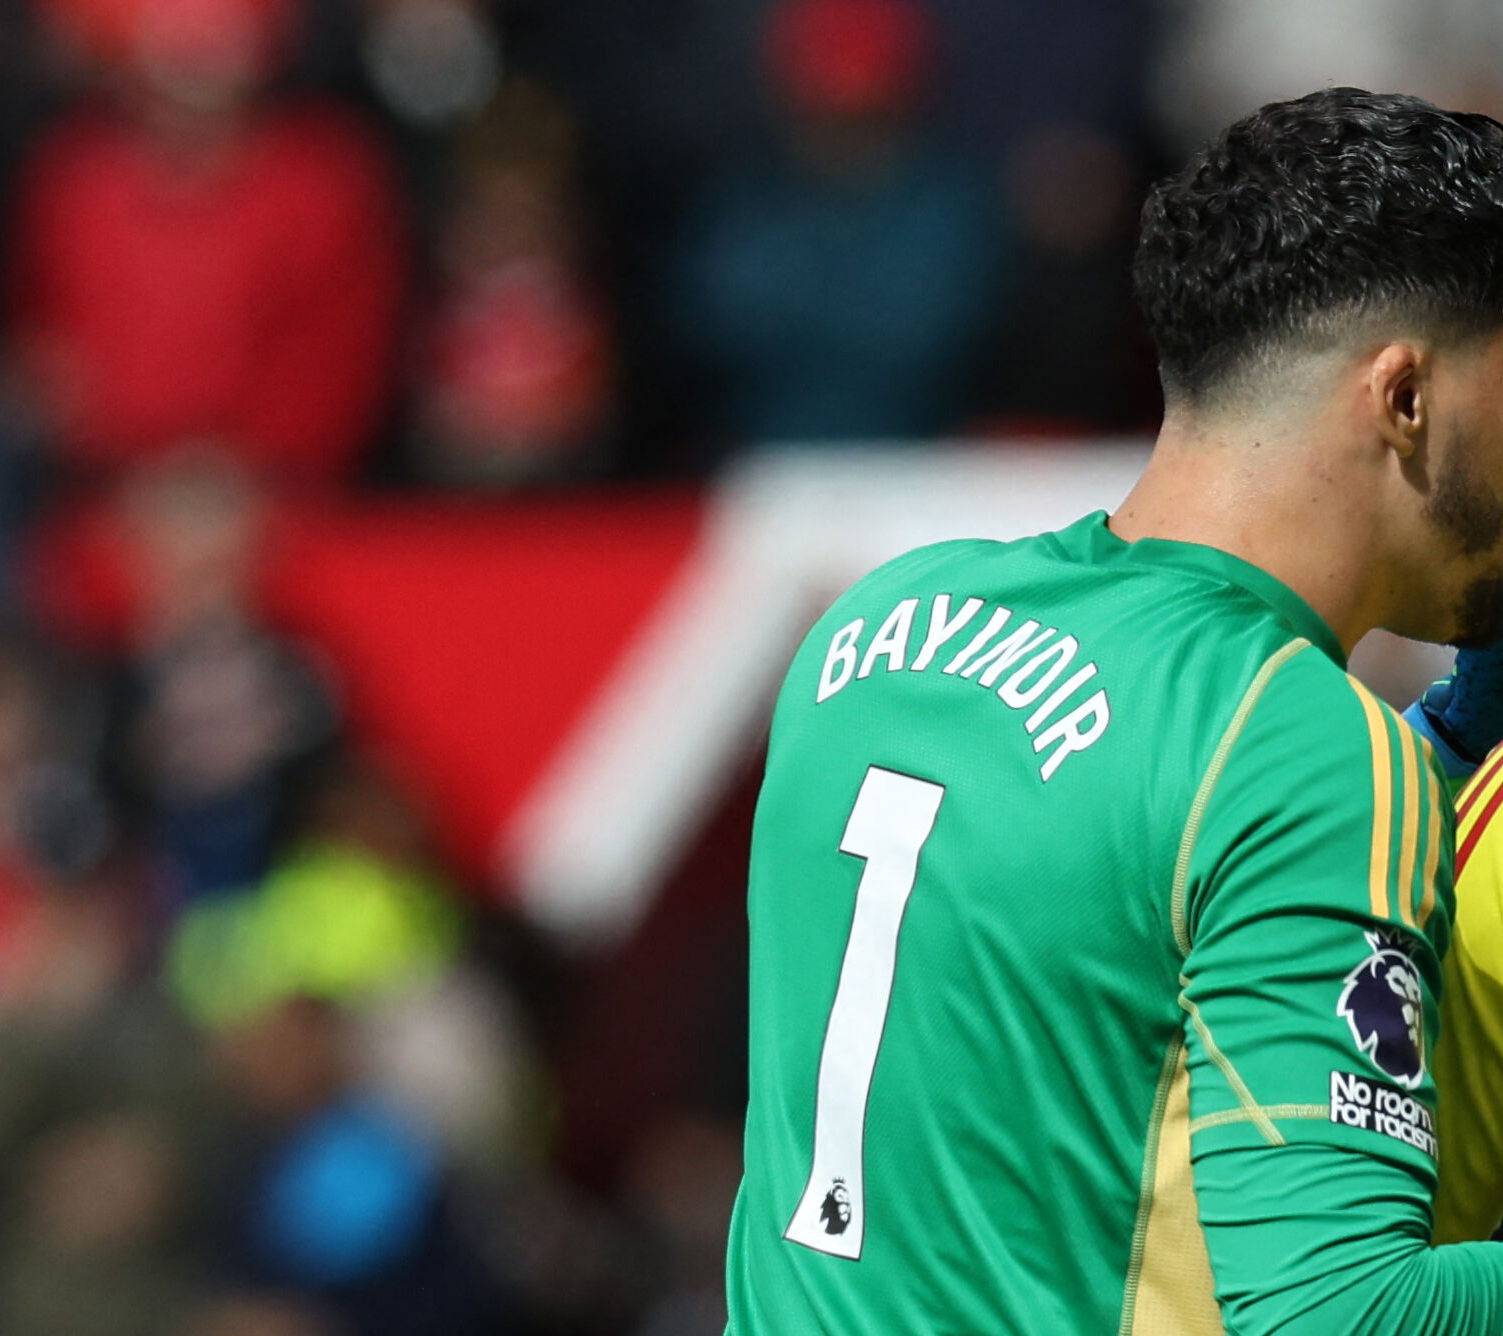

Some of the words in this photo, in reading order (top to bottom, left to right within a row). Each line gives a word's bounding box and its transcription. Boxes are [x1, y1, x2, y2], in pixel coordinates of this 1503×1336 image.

[815, 593, 1112, 784] BAYINDIR
[783, 765, 946, 1261] 1
[1330, 1070, 1372, 1106] No
[1375, 1087, 1434, 1133] room
[1374, 1110, 1439, 1161] racism
